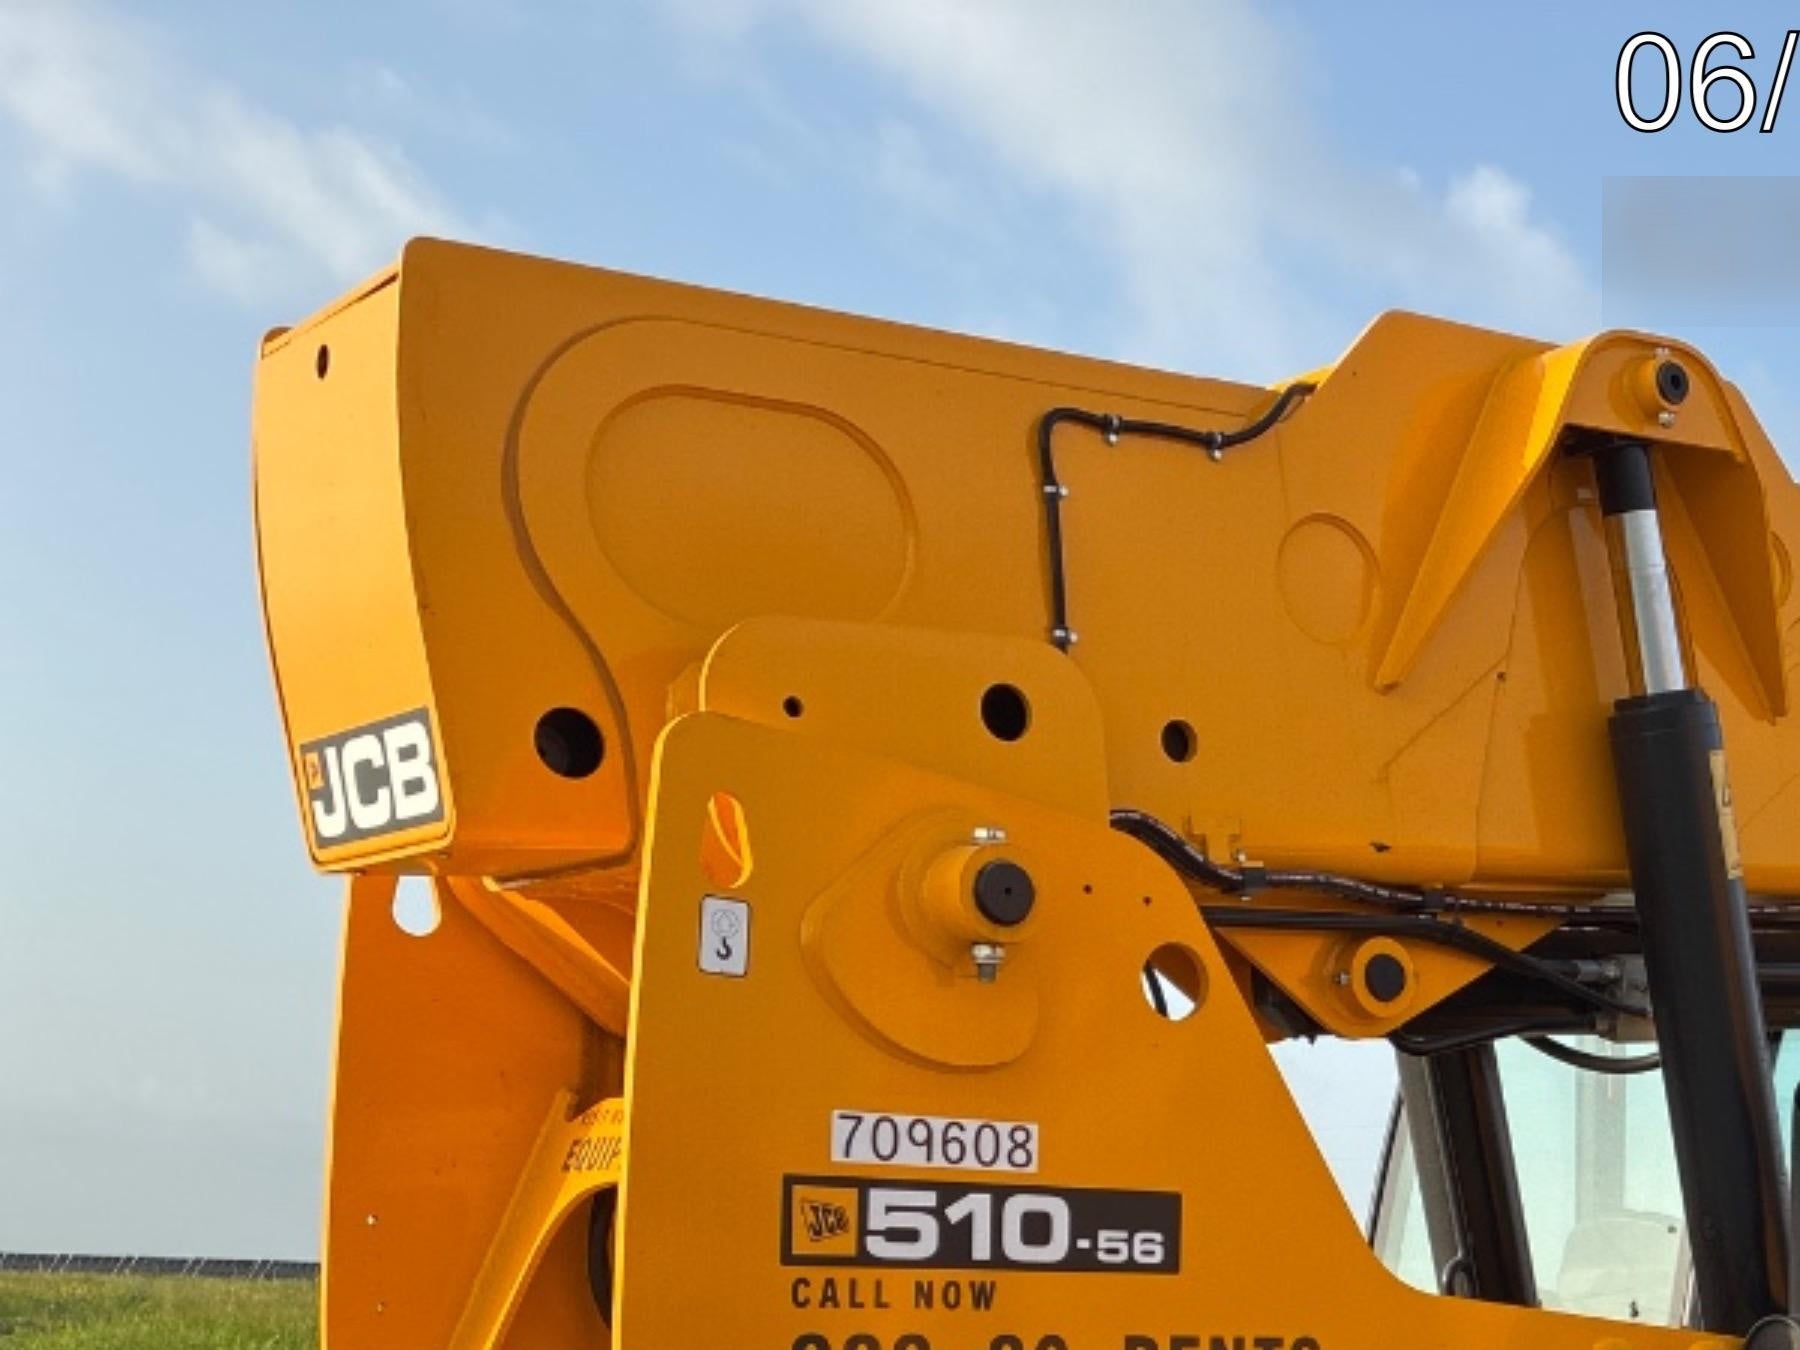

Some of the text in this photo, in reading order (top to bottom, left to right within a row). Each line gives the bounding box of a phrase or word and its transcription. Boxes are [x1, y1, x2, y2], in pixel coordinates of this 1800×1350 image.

[312, 720, 439, 838] JCB
[838, 1112, 1033, 1168] 709608
[791, 1277, 997, 1311] CALL NOW
